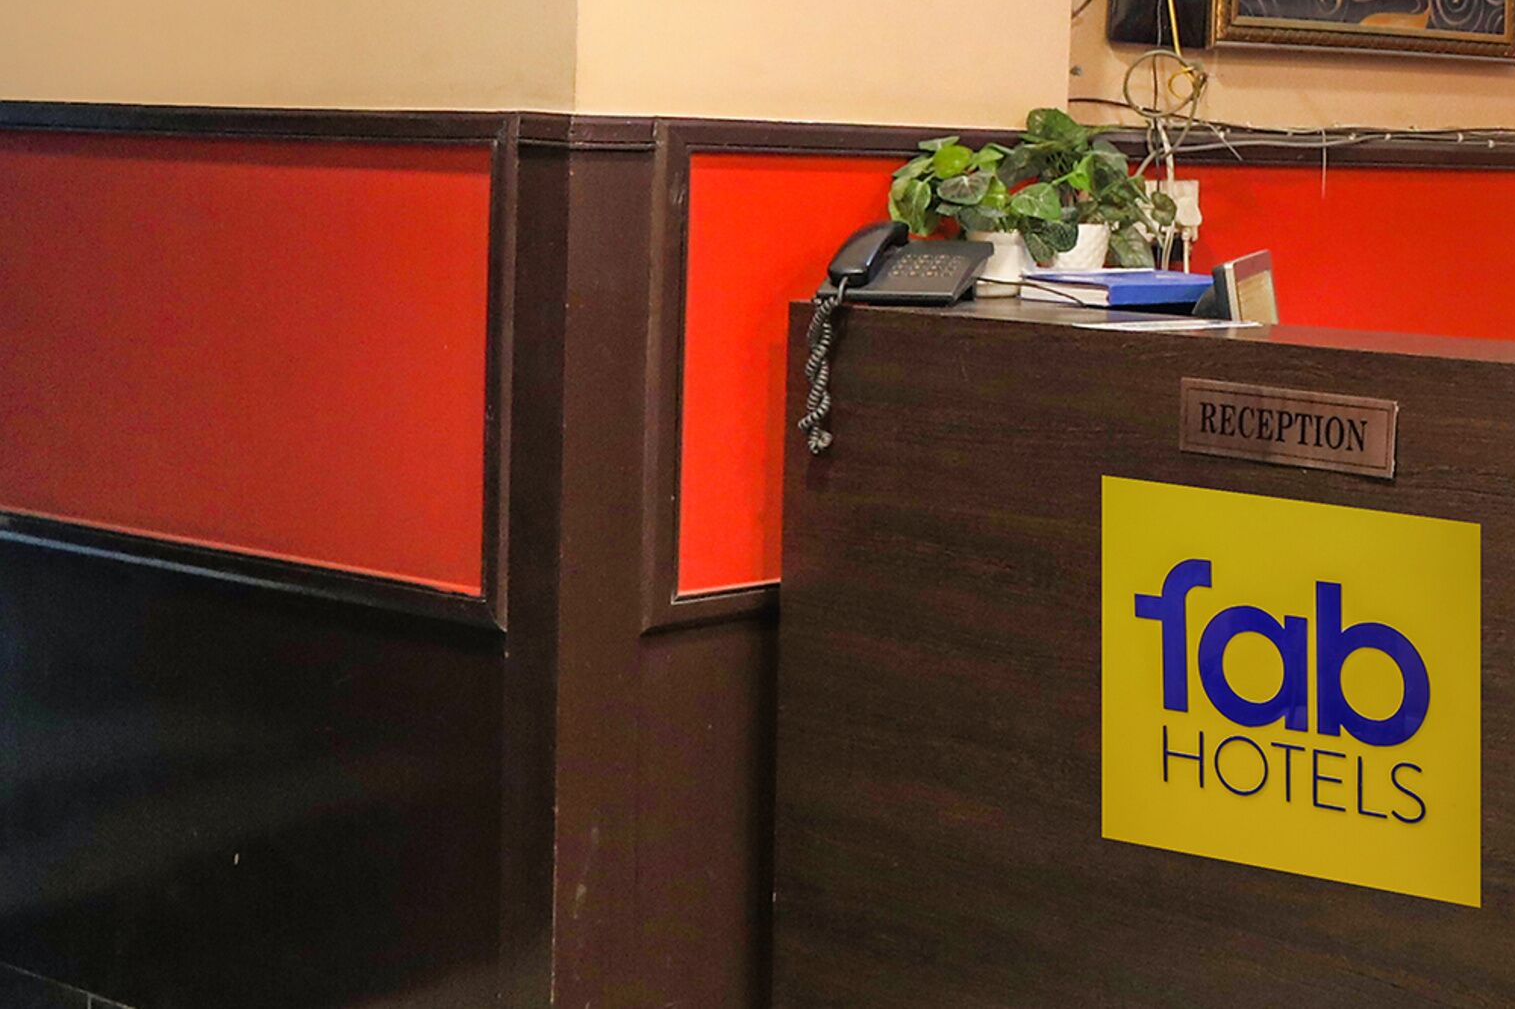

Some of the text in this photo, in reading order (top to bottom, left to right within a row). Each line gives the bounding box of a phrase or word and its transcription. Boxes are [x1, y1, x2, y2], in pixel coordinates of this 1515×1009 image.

[1199, 402, 1368, 452] RECEPTION
[1134, 558, 1431, 748] fab
[1162, 725, 1428, 825] HOTELS
